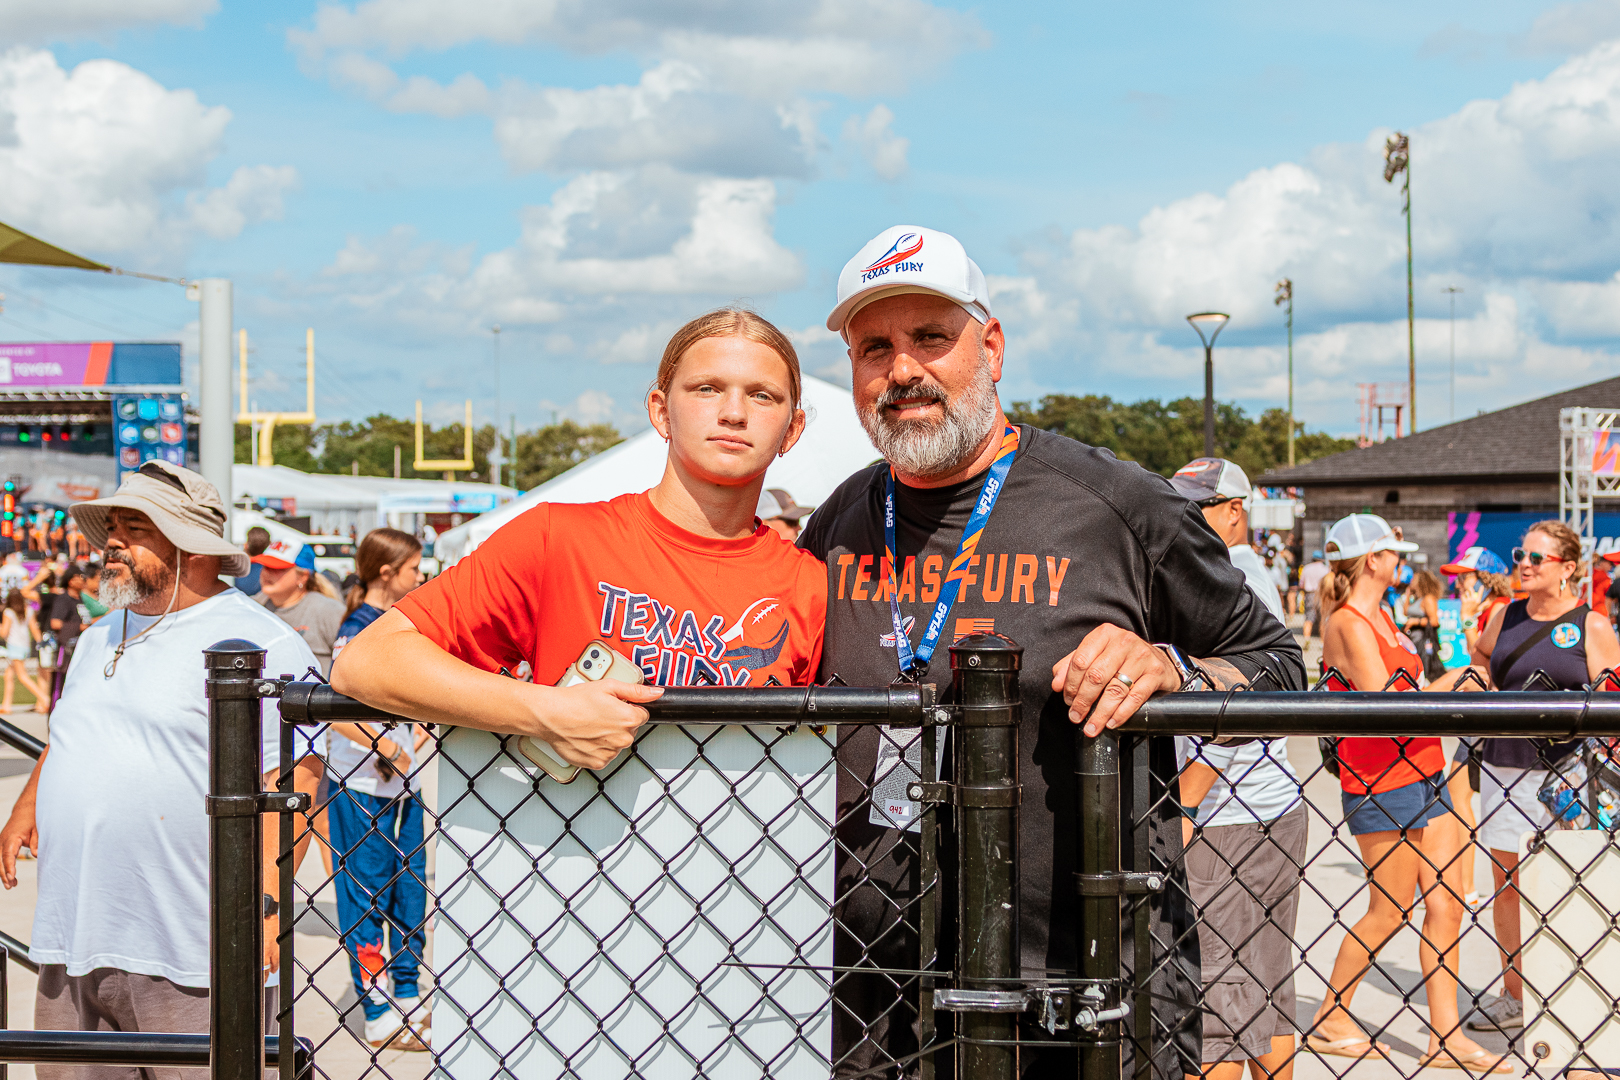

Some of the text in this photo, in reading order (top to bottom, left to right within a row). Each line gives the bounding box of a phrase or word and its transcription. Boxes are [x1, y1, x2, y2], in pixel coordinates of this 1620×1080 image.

[861, 262, 923, 283] TEXAS FURY
[13, 362, 63, 377] TOYOTA
[837, 553, 1071, 606] TEXAS FURY
[597, 581, 727, 661] TEXAS
